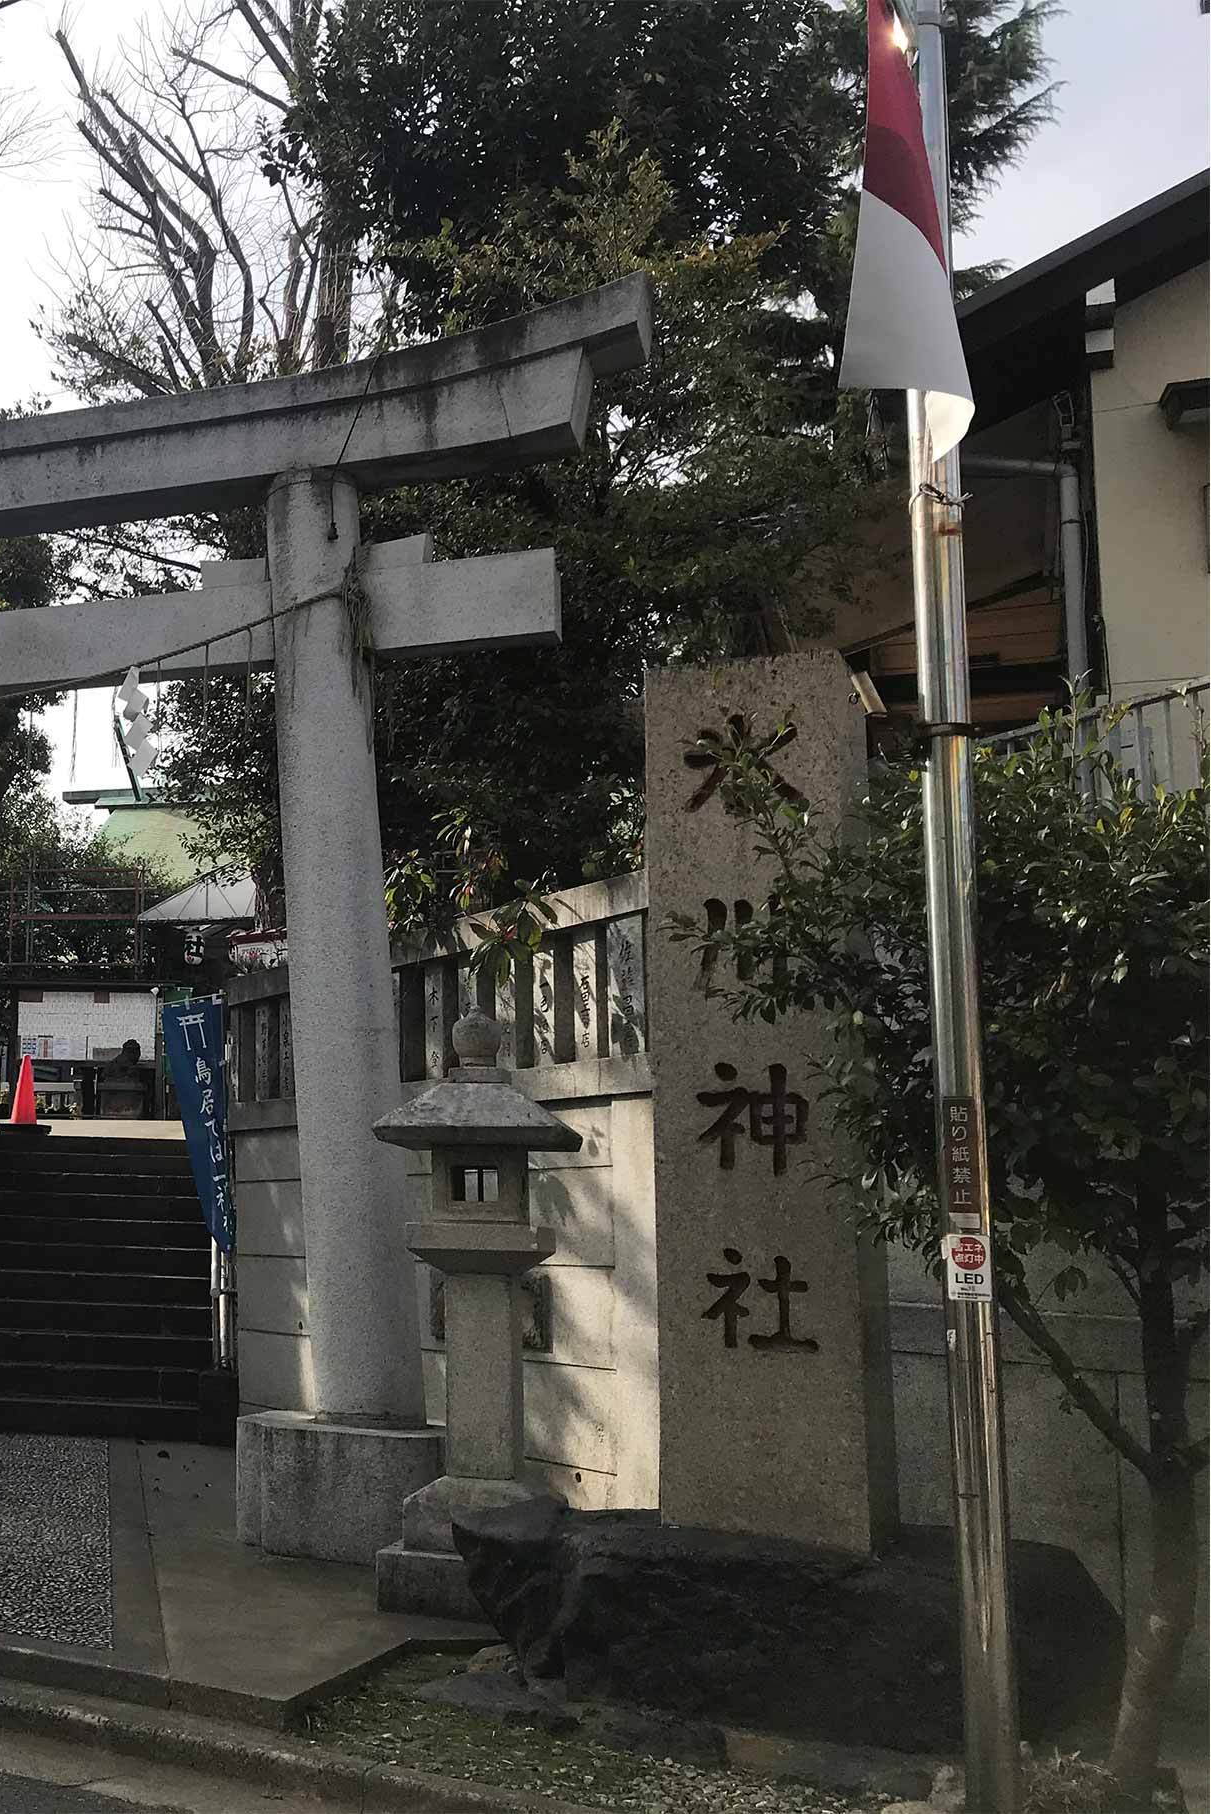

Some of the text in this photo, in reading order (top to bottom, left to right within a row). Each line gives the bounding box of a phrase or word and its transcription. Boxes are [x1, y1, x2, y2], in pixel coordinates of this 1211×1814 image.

[683, 713, 818, 1352] 氷川神社
[949, 1105, 973, 1206] 貼り紙禁止
[955, 1254, 984, 1264] 点灯中
[955, 1273, 984, 1284] LED
